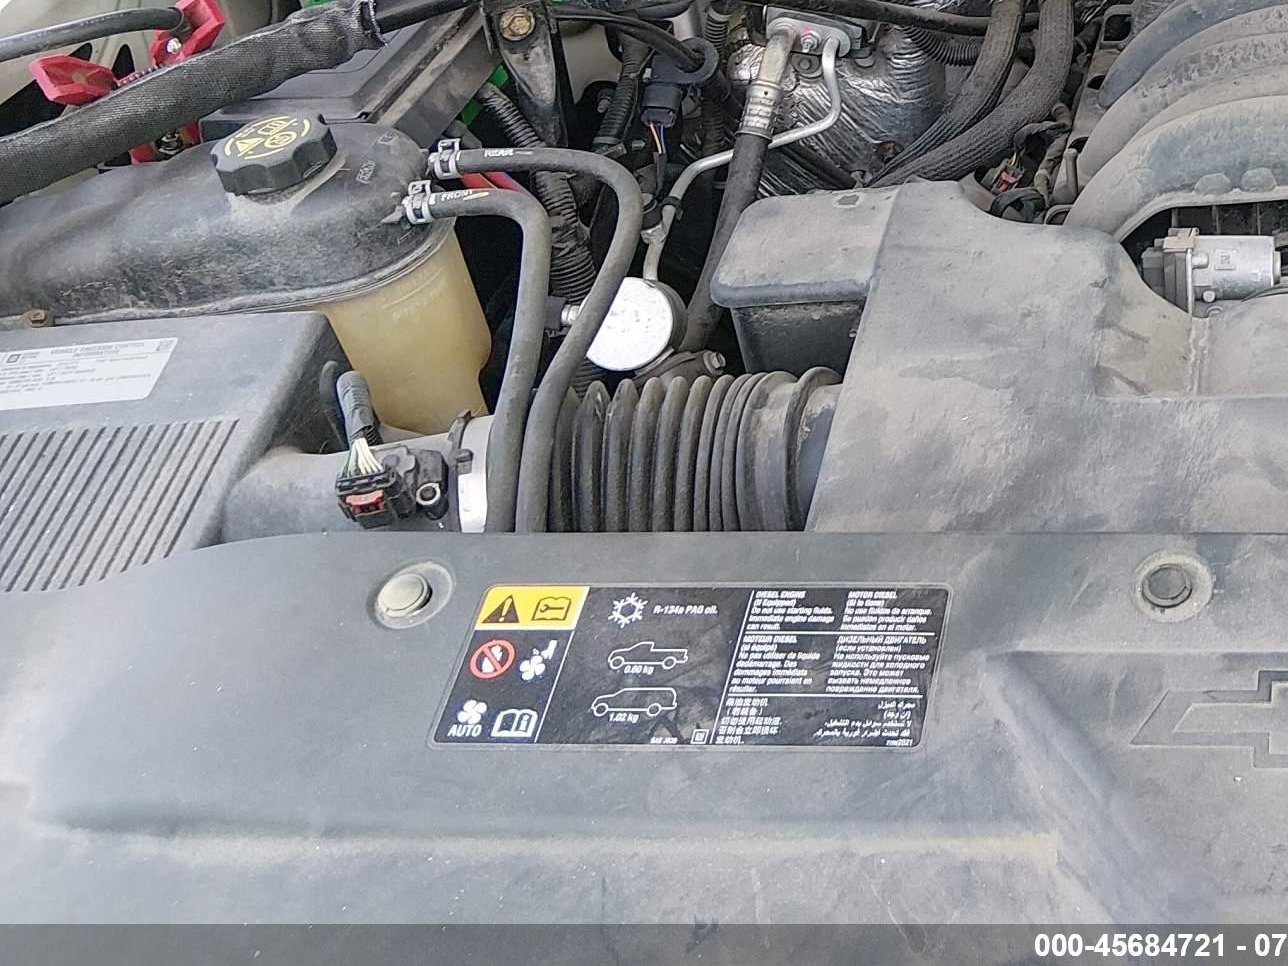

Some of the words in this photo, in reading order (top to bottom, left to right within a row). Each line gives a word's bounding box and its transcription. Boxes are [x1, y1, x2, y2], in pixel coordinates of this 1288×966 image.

[441, 190, 472, 201] FRONT
[847, 591, 873, 599] MOTOR
[684, 605, 704, 614] PAG
[836, 634, 884, 644] ДИЗЕЛЬНЫЙ
[884, 636, 927, 644] ДВИГАТЕЛЬ
[642, 664, 655, 675] kg
[626, 713, 640, 723] kg
[447, 724, 482, 737] AUTO
